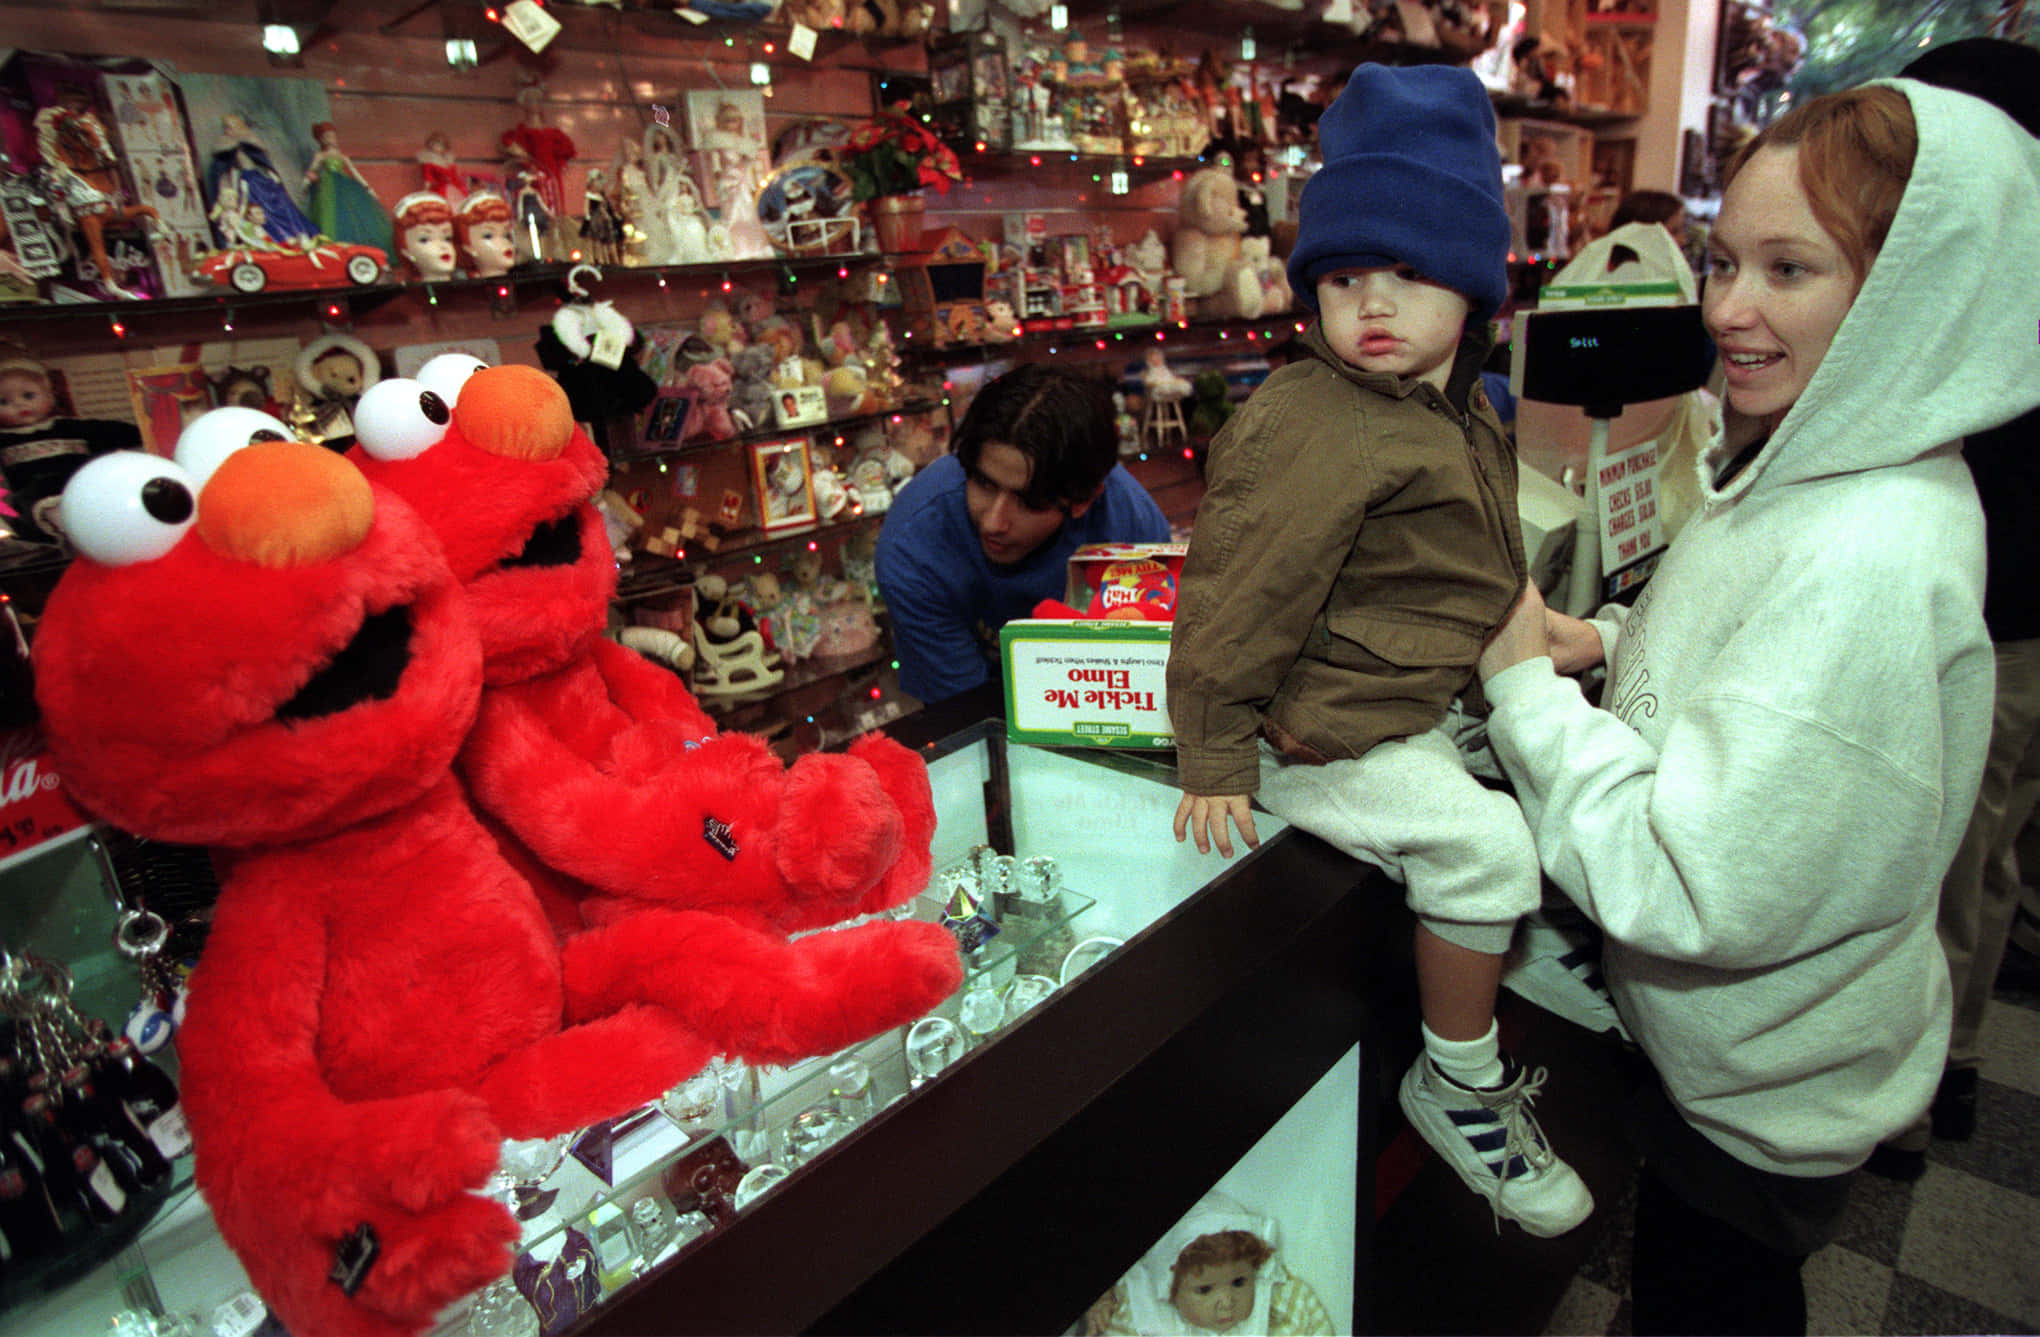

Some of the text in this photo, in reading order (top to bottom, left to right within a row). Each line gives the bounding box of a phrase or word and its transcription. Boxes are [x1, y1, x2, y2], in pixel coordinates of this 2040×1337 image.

[1618, 530, 1652, 561] THANK YOU
[1067, 669, 1130, 689] Elmo
[1044, 690, 1158, 711] Tickle Me
[1075, 724, 1128, 735] SESAME STREET
